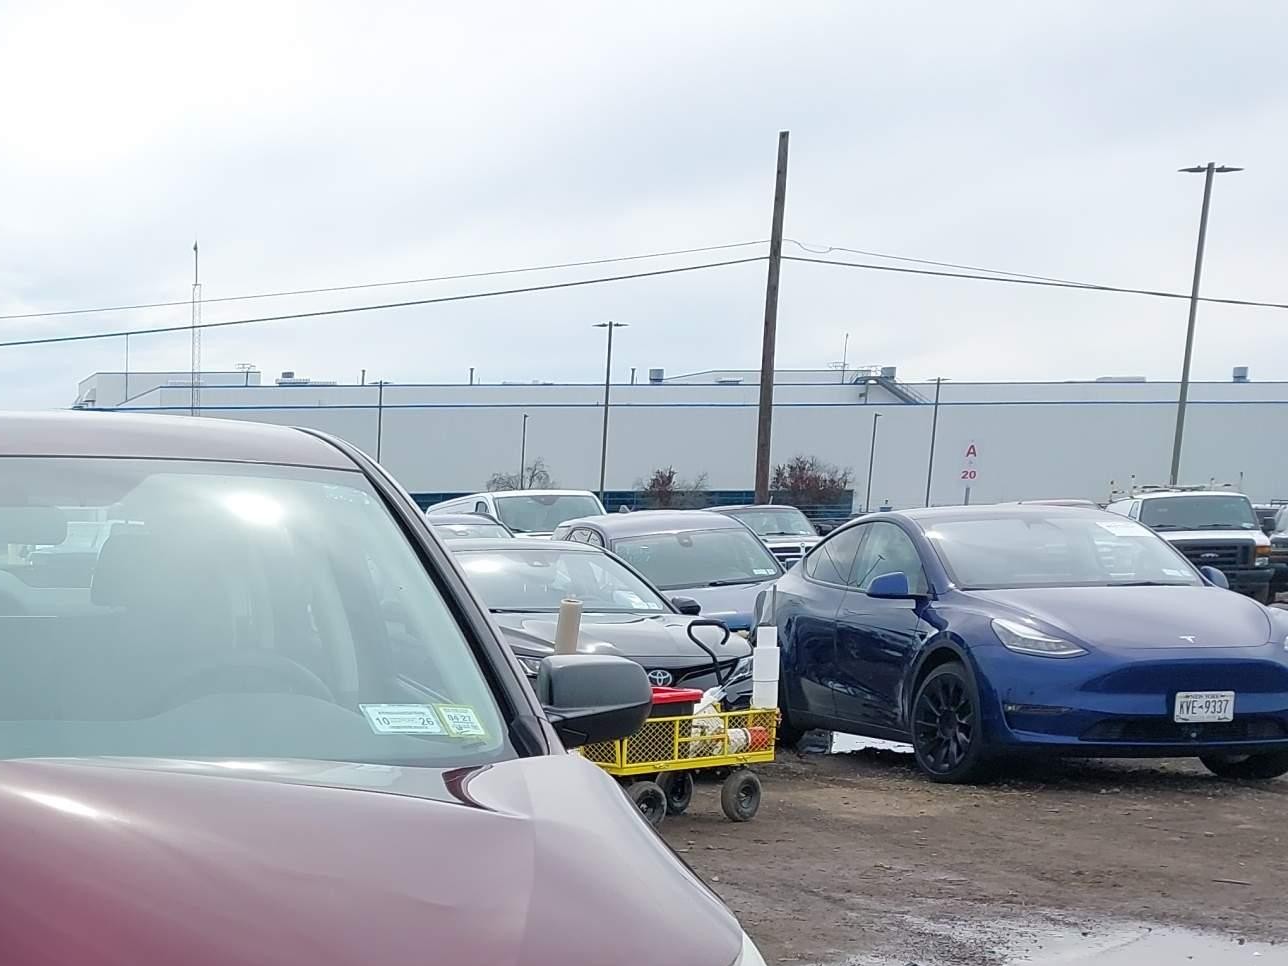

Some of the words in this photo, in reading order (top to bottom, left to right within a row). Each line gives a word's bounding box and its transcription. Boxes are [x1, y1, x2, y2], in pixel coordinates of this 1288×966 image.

[966, 444, 977, 458] A
[961, 470, 977, 480] 20
[375, 716, 391, 726] 10
[418, 717, 434, 726] 26
